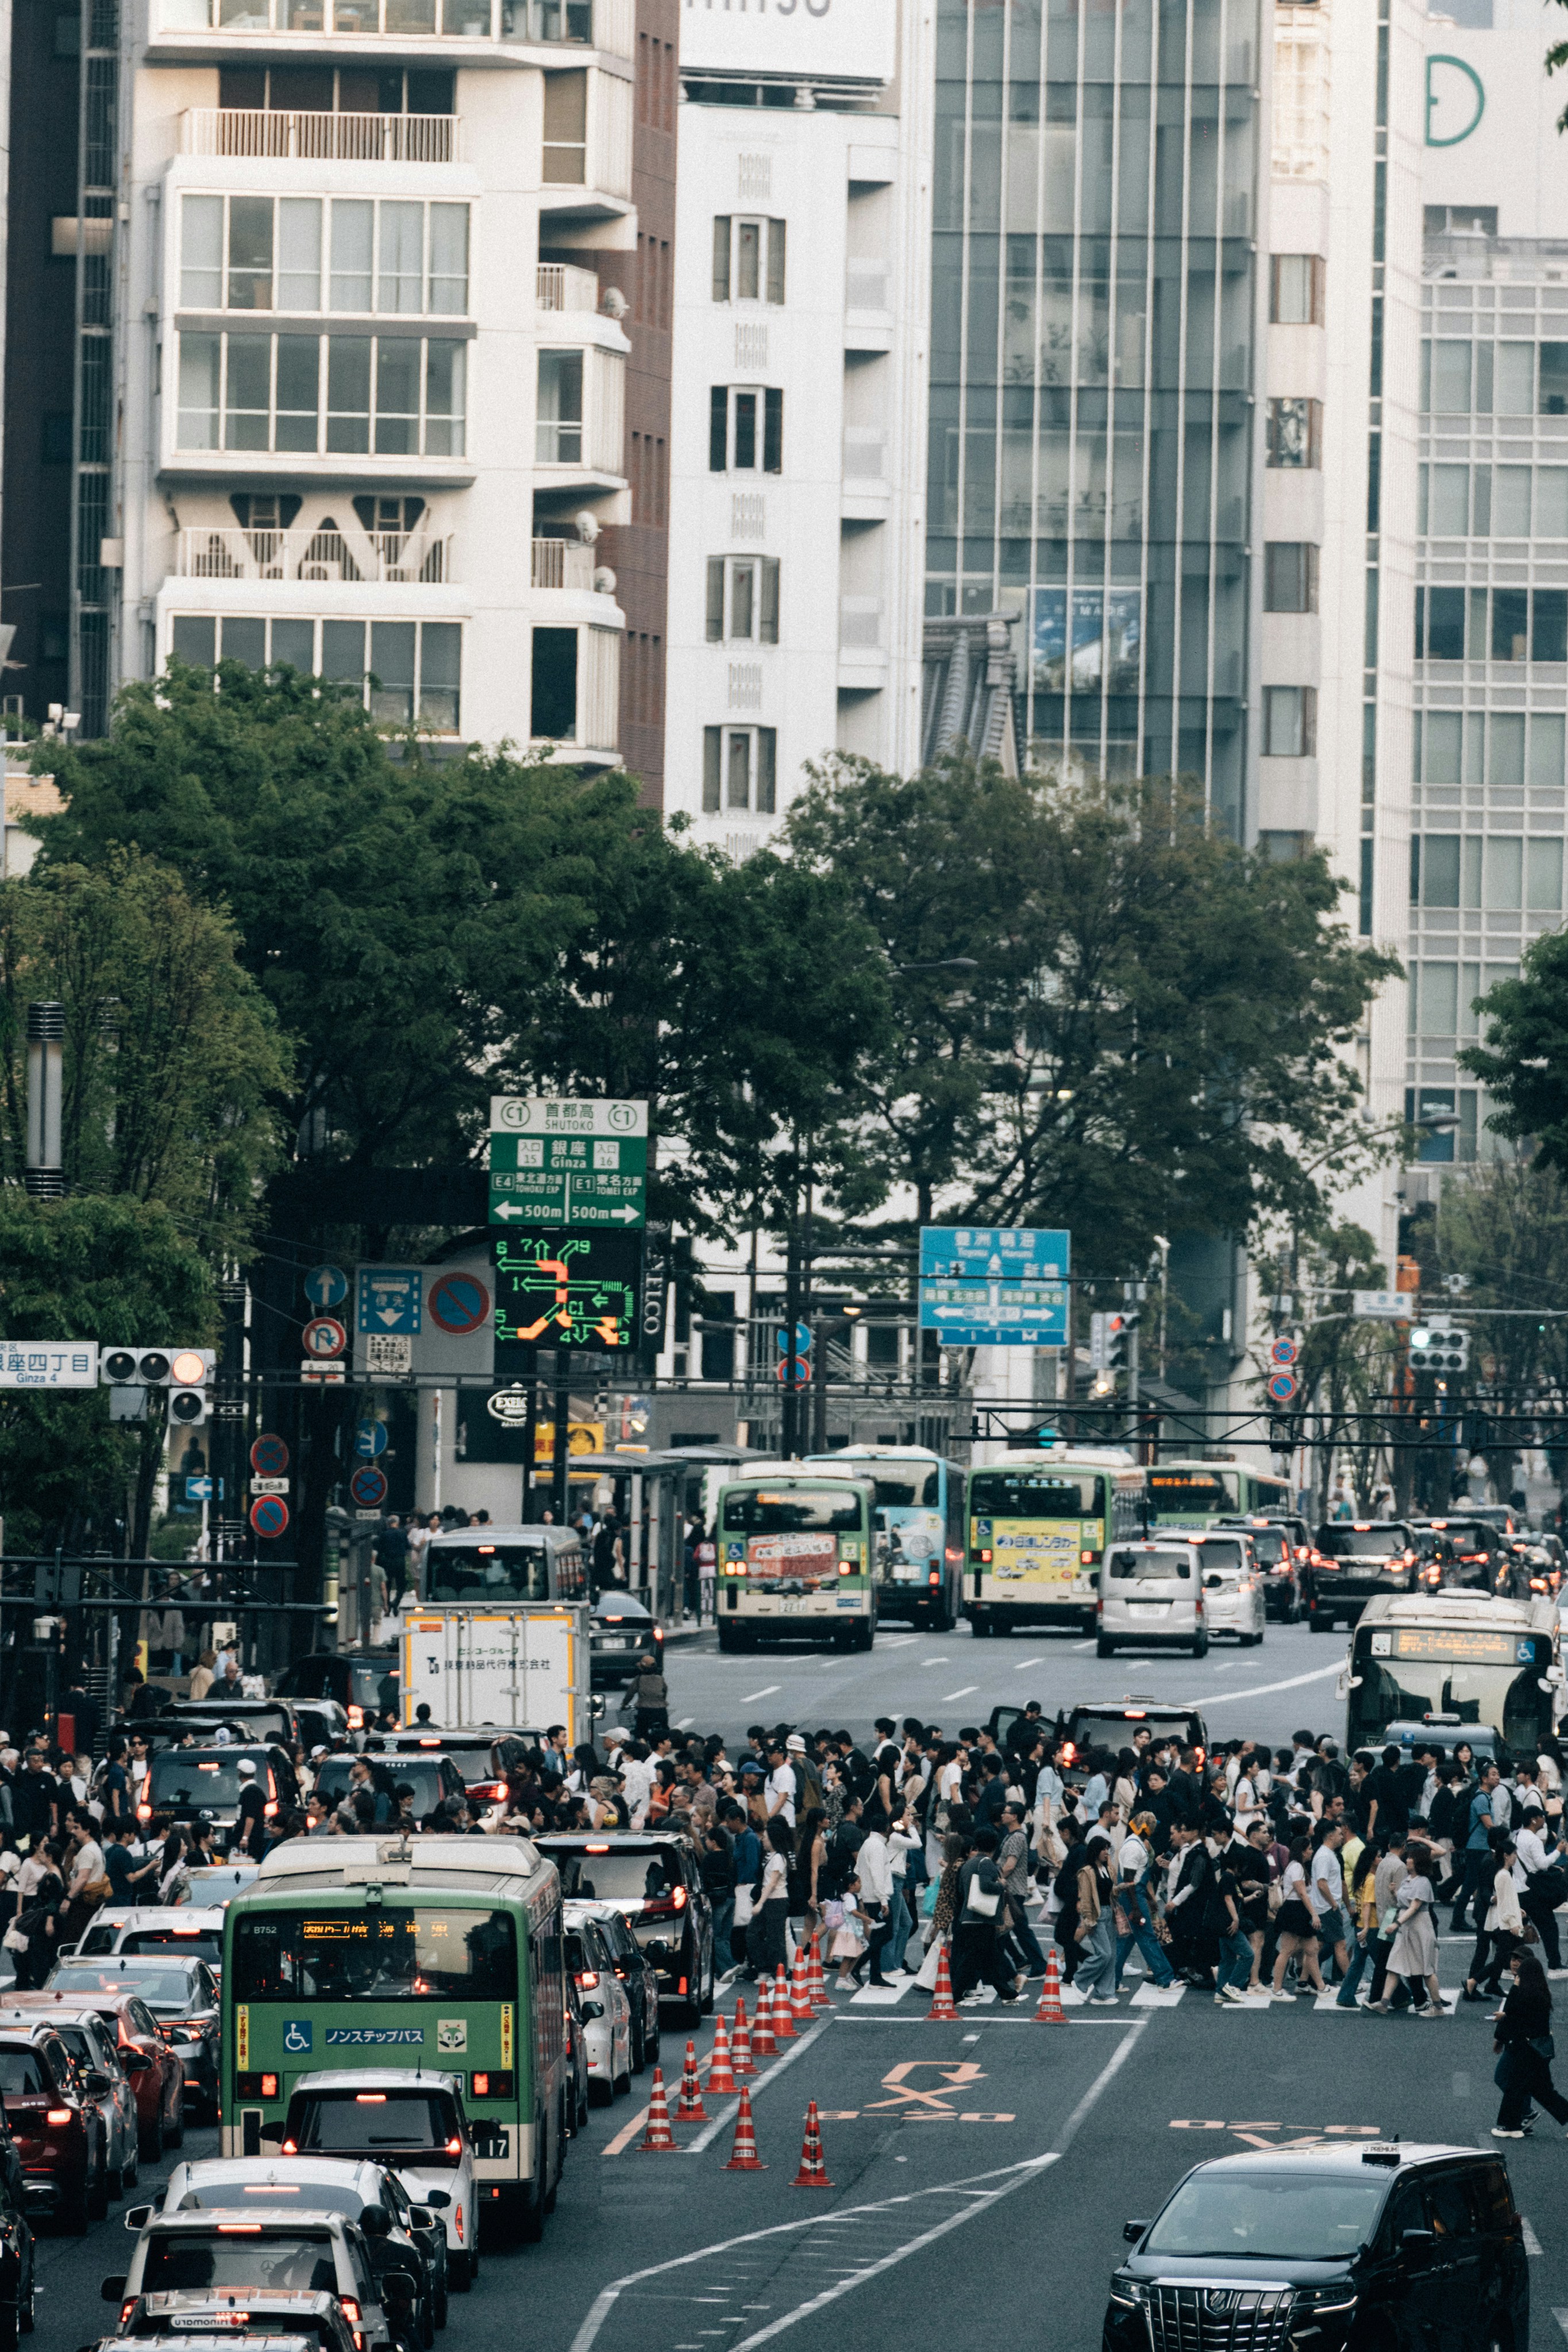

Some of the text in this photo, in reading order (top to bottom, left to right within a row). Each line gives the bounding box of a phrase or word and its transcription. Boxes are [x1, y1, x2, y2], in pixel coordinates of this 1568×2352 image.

[507, 1107, 523, 1121] C1
[546, 1103, 594, 1118] 首都高
[614, 1111, 629, 1125] C1
[546, 1120, 594, 1130] SHUTOKO
[522, 1142, 541, 1151] 入口
[552, 1140, 587, 1156] 銀座
[597, 1144, 617, 1153] 入口
[525, 1154, 537, 1163] 15
[551, 1157, 587, 1168] Ginza
[600, 1157, 612, 1166] 16
[496, 1177, 511, 1187] E4
[576, 1179, 591, 1189] E1
[597, 1175, 642, 1186] 東名方面
[525, 1205, 562, 1218] 500m
[572, 1206, 609, 1219] 500m
[521, 1238, 532, 1252] 7
[579, 1239, 591, 1254] 9
[568, 1301, 584, 1315] C1
[495, 1309, 506, 1323] 5
[560, 1330, 571, 1342] 4
[618, 1331, 629, 1344] 3
[0, 1354, 88, 1372] 座四丁目
[16, 1372, 57, 1383] Ginza 4
[326, 2030, 423, 2043] ノンステップバス
